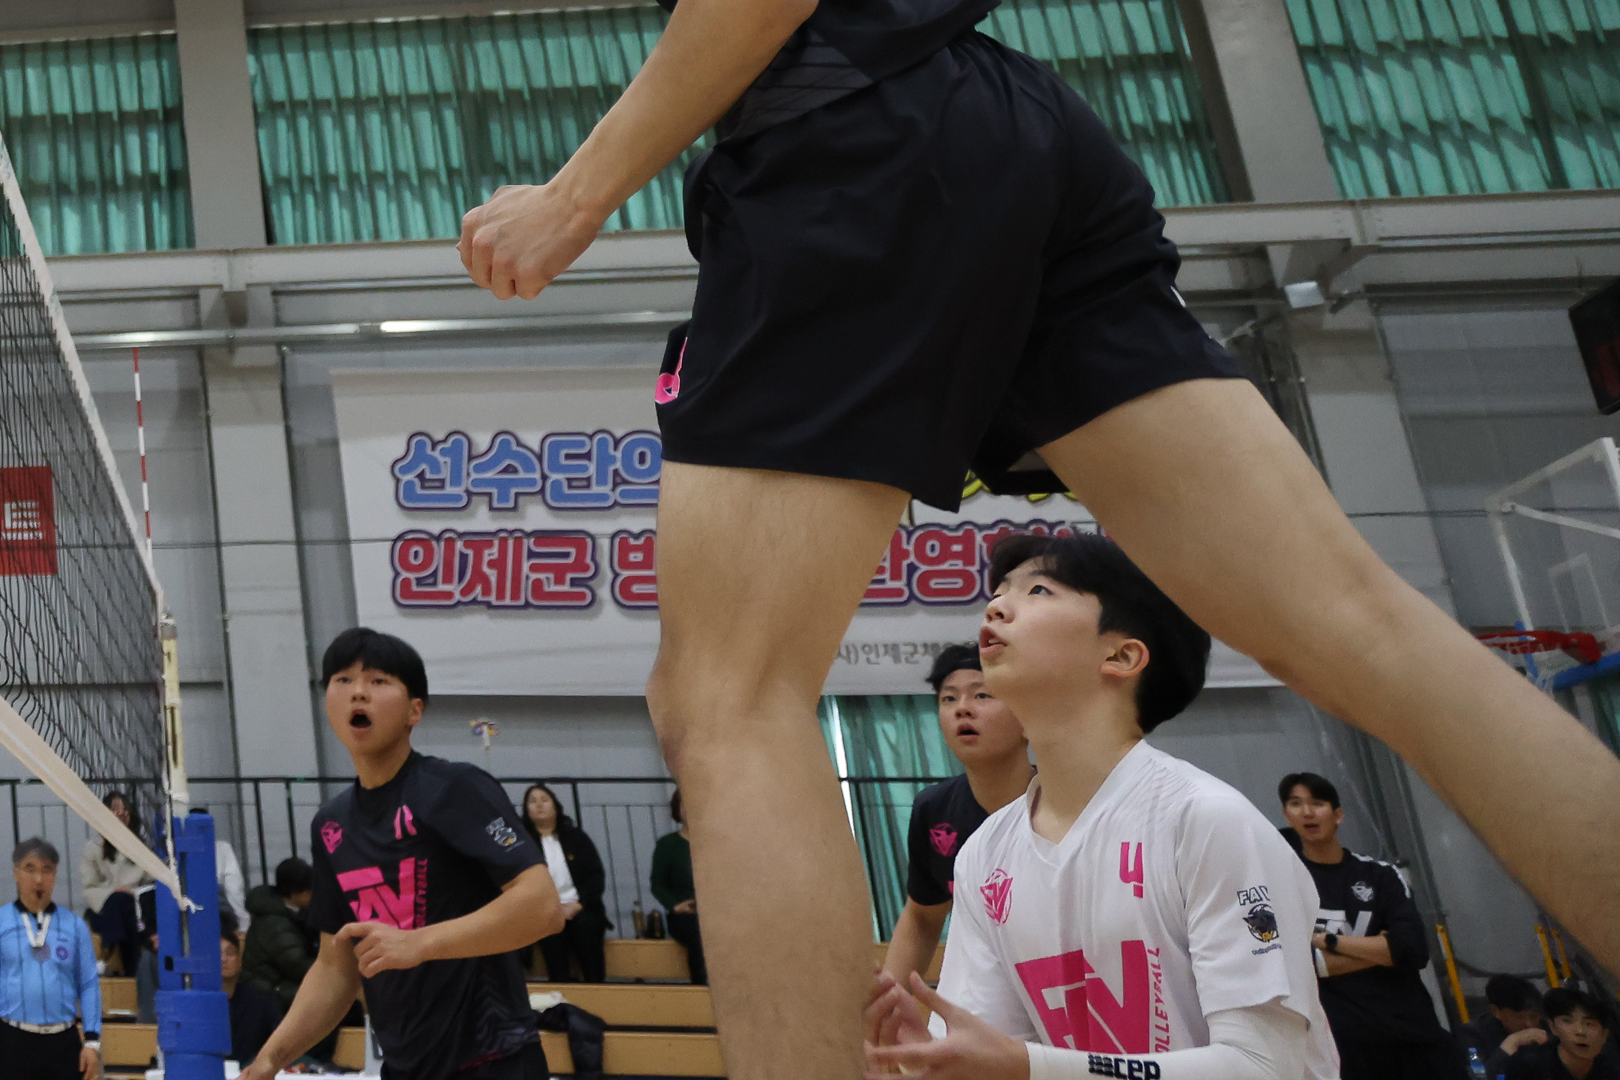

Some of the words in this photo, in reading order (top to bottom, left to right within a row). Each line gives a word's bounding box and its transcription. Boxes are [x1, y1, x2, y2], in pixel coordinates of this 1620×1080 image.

[392, 529, 597, 609] 인제군
[1118, 841, 1145, 899] 4
[1147, 946, 1171, 1054] OLLEYBALL
